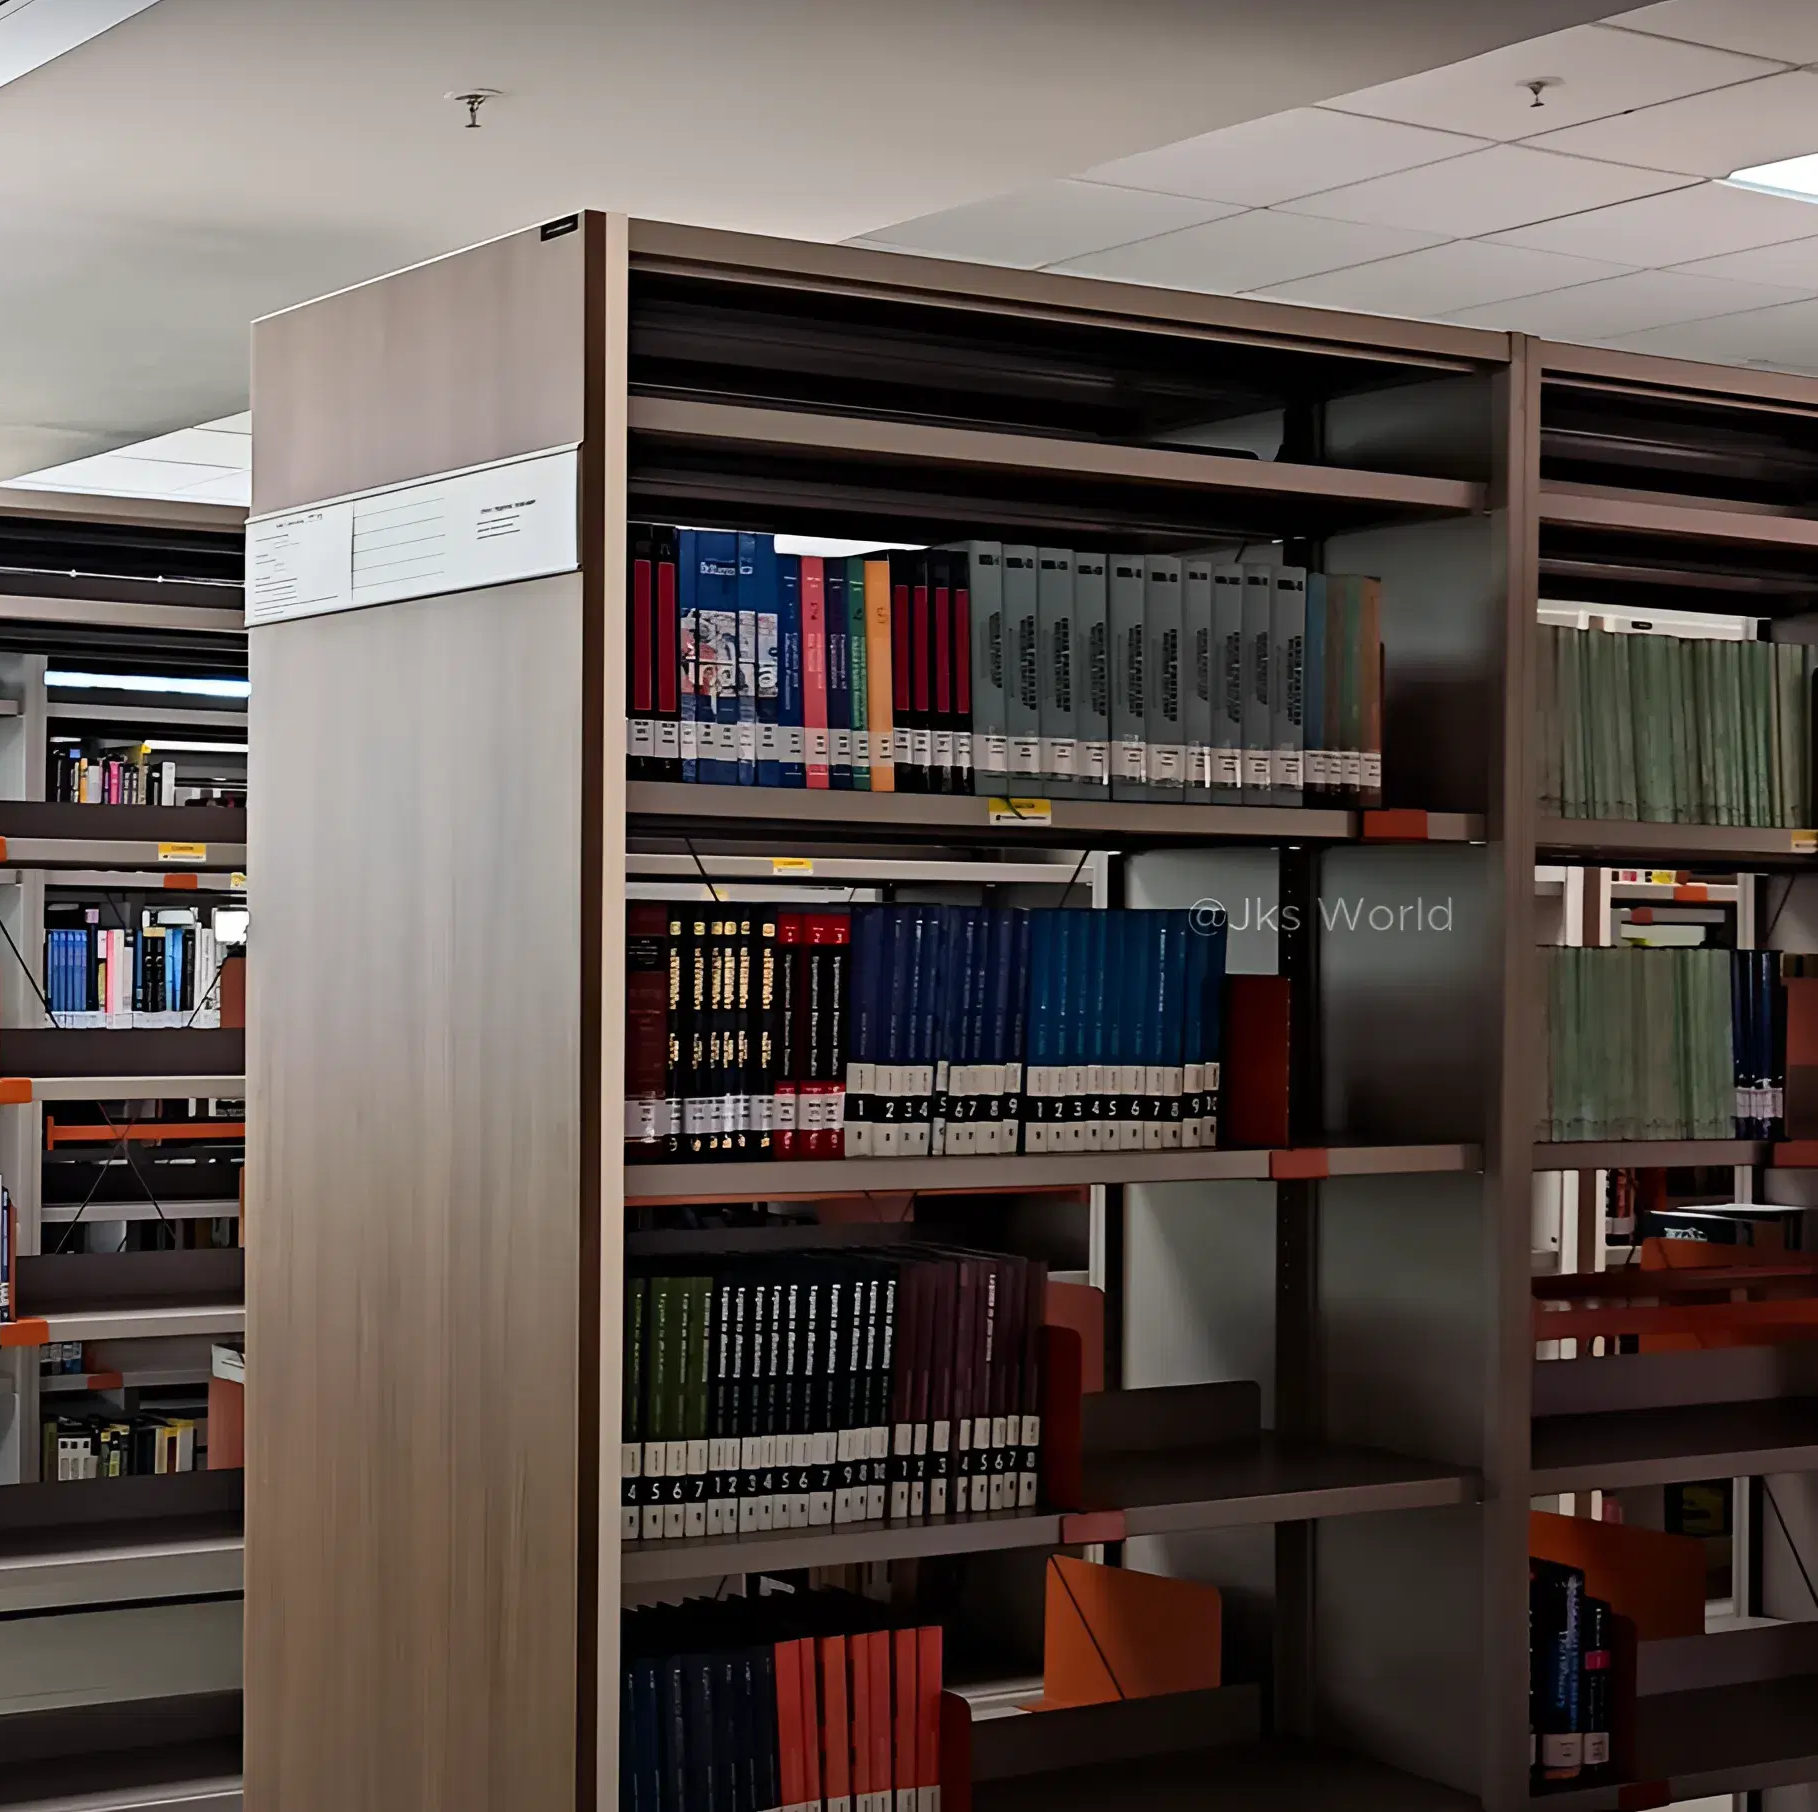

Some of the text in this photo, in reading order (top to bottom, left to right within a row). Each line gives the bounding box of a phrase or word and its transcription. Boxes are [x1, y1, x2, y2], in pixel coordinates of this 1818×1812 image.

[886, 1102, 896, 1118] 2
[955, 1101, 964, 1118] 6
[969, 1101, 979, 1117] 7
[991, 1100, 1000, 1116] 8
[1055, 1102, 1064, 1118] 2
[1073, 1102, 1083, 1117] 3
[1108, 1100, 1118, 1116] 5
[1131, 1100, 1141, 1116] 6
[1153, 1101, 1162, 1116] 7
[1192, 1098, 1200, 1113] 9
[995, 1453, 1005, 1470] 6
[1009, 1451, 1017, 1467] 7
[844, 1466, 853, 1483] 9
[902, 1461, 908, 1477] 1
[716, 1477, 721, 1493] 1
[729, 1476, 738, 1493] 2
[782, 1472, 791, 1489] 5
[799, 1472, 809, 1489] 6
[823, 1470, 831, 1486] 7
[652, 1483, 661, 1500] 5
[673, 1482, 683, 1499] 6
[696, 1481, 705, 1498] 7
